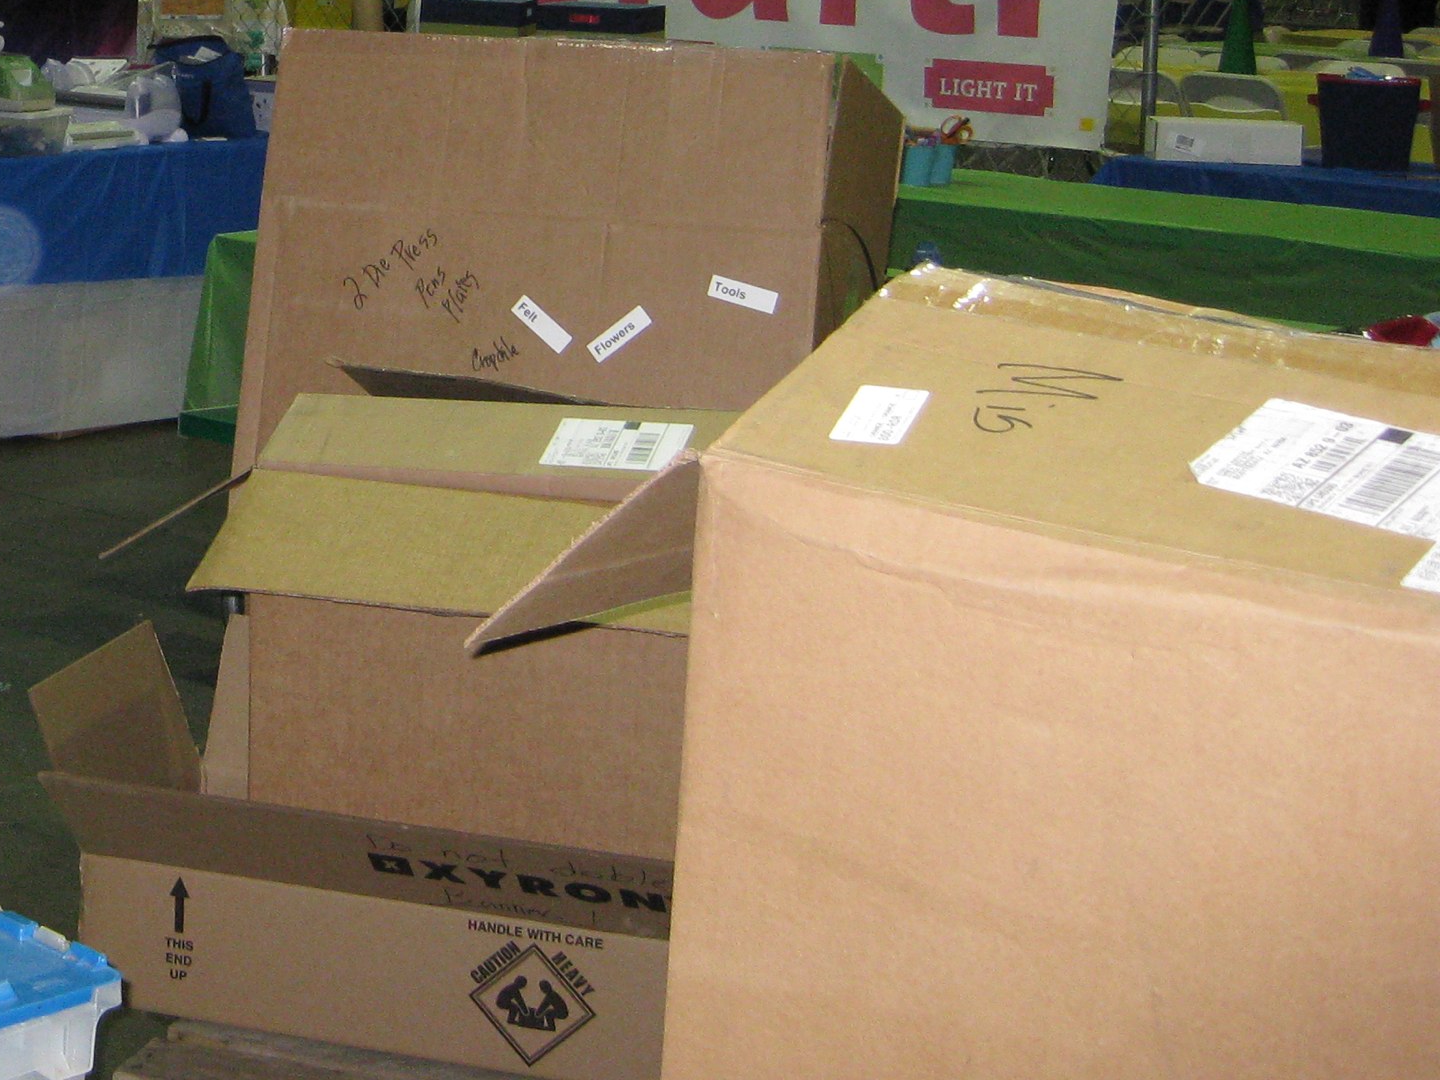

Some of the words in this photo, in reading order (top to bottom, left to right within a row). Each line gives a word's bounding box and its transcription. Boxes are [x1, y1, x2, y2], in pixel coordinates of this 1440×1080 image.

[939, 77, 1007, 101] LIGHT
[1014, 82, 1038, 103] IT
[391, 228, 437, 270] Press
[715, 281, 747, 300] Tools
[517, 302, 537, 322] Felt
[594, 319, 635, 356] Flowers
[165, 936, 194, 952] THIS
[468, 919, 522, 937] HANDLE
[527, 927, 561, 943] WITH
[565, 934, 604, 950] CARE
[166, 952, 192, 968] END
[470, 940, 520, 985] CAUTION
[170, 968, 187, 982] UP
[551, 951, 596, 998] HEAVY
